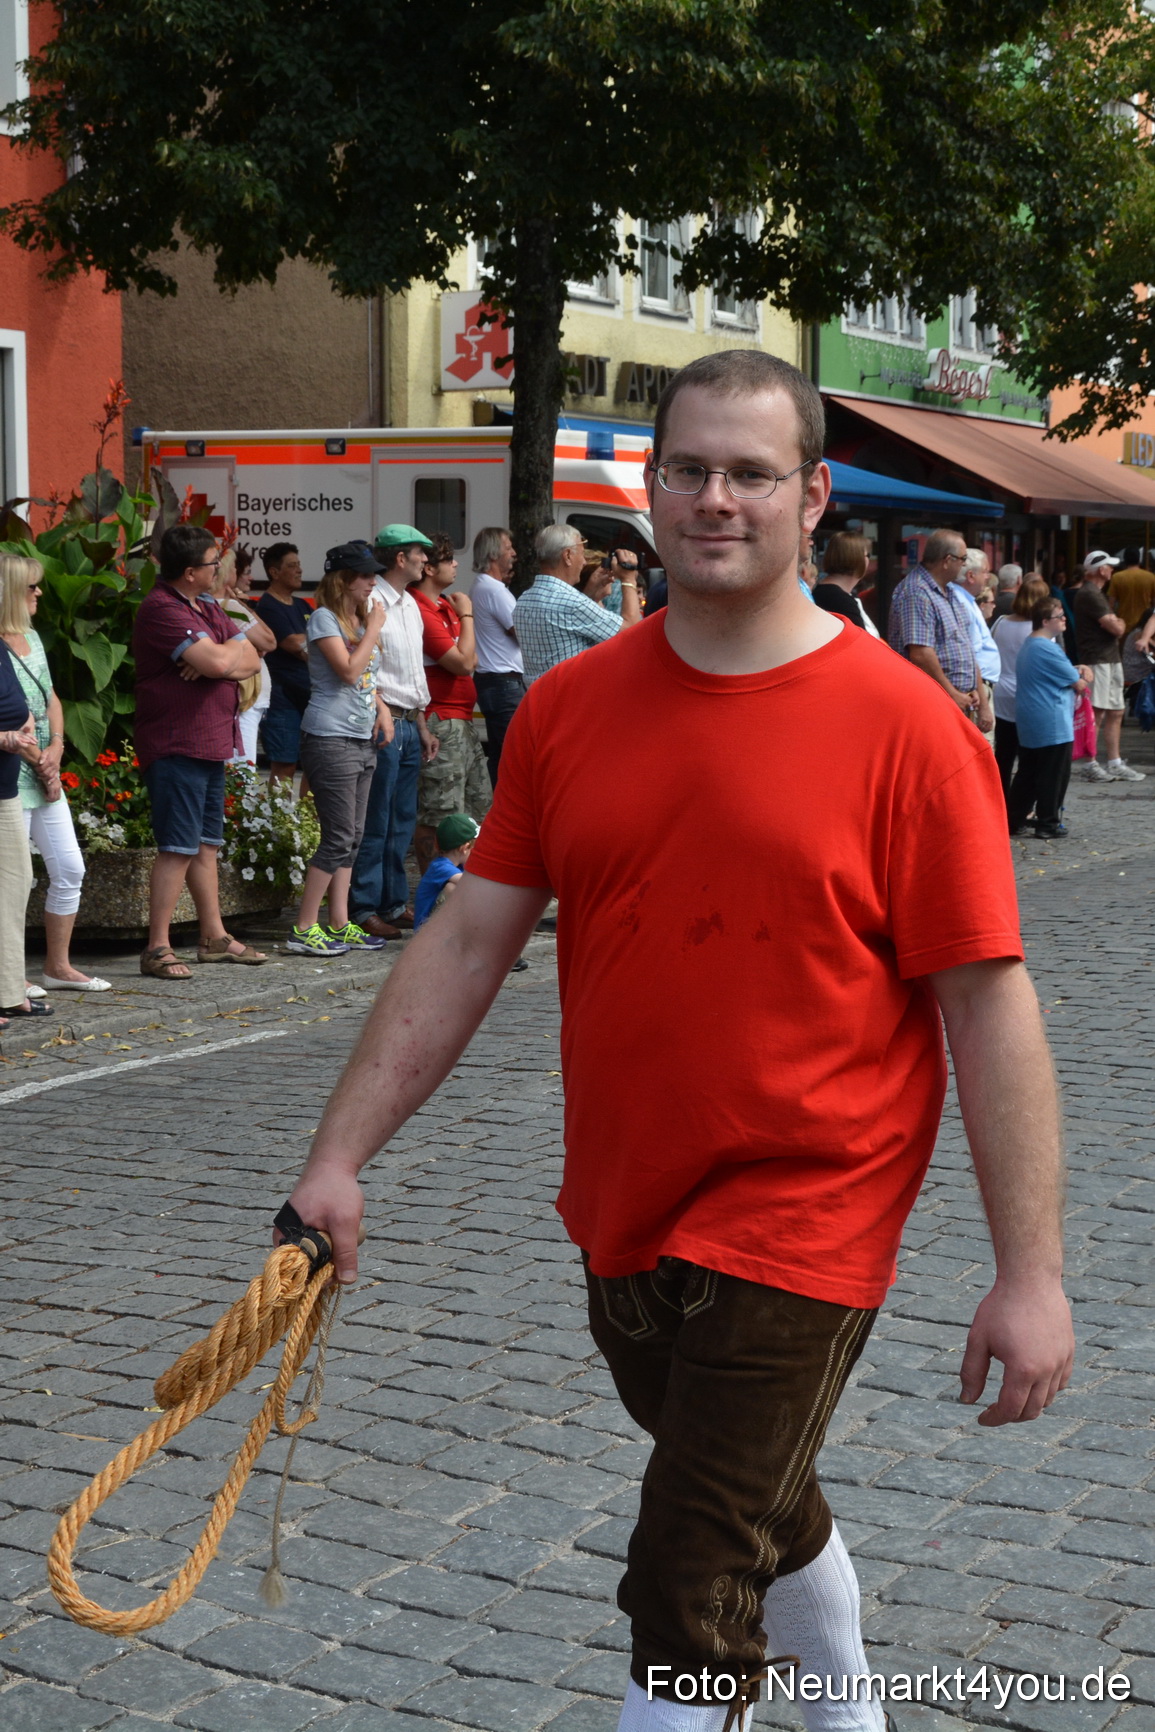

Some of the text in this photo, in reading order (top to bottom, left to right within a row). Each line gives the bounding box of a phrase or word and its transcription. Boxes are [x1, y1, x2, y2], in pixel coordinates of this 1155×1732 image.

[562, 351, 681, 404] ADT APO
[237, 492, 354, 516] Bayerisches
[237, 517, 293, 537] Rotes
[237, 541, 268, 561] Kre
